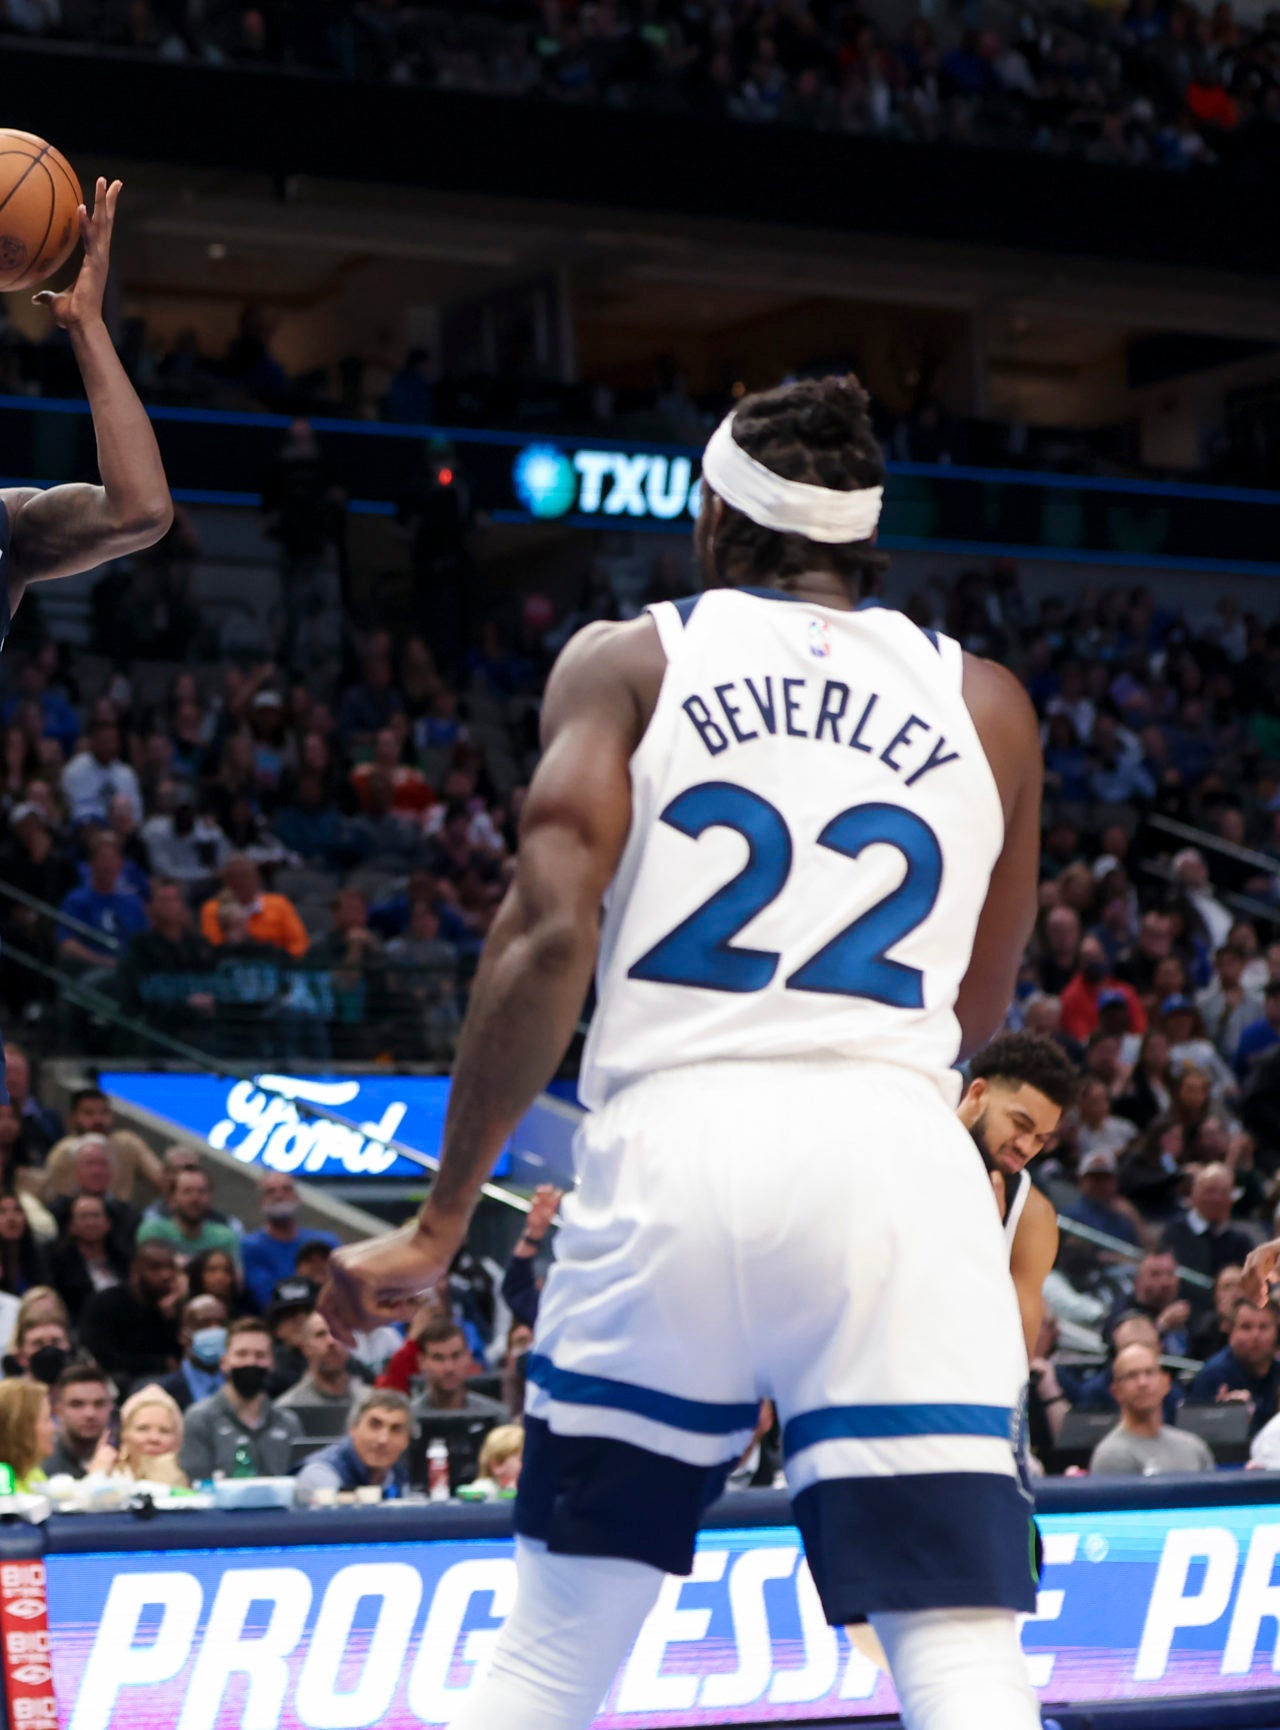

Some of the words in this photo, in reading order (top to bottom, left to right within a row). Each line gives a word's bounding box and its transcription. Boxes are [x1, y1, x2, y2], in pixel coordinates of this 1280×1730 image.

[573, 449, 691, 520] TXU
[682, 675, 960, 787] BEVERLEY
[627, 781, 943, 1010] 22
[208, 1074, 408, 1174] Ford
